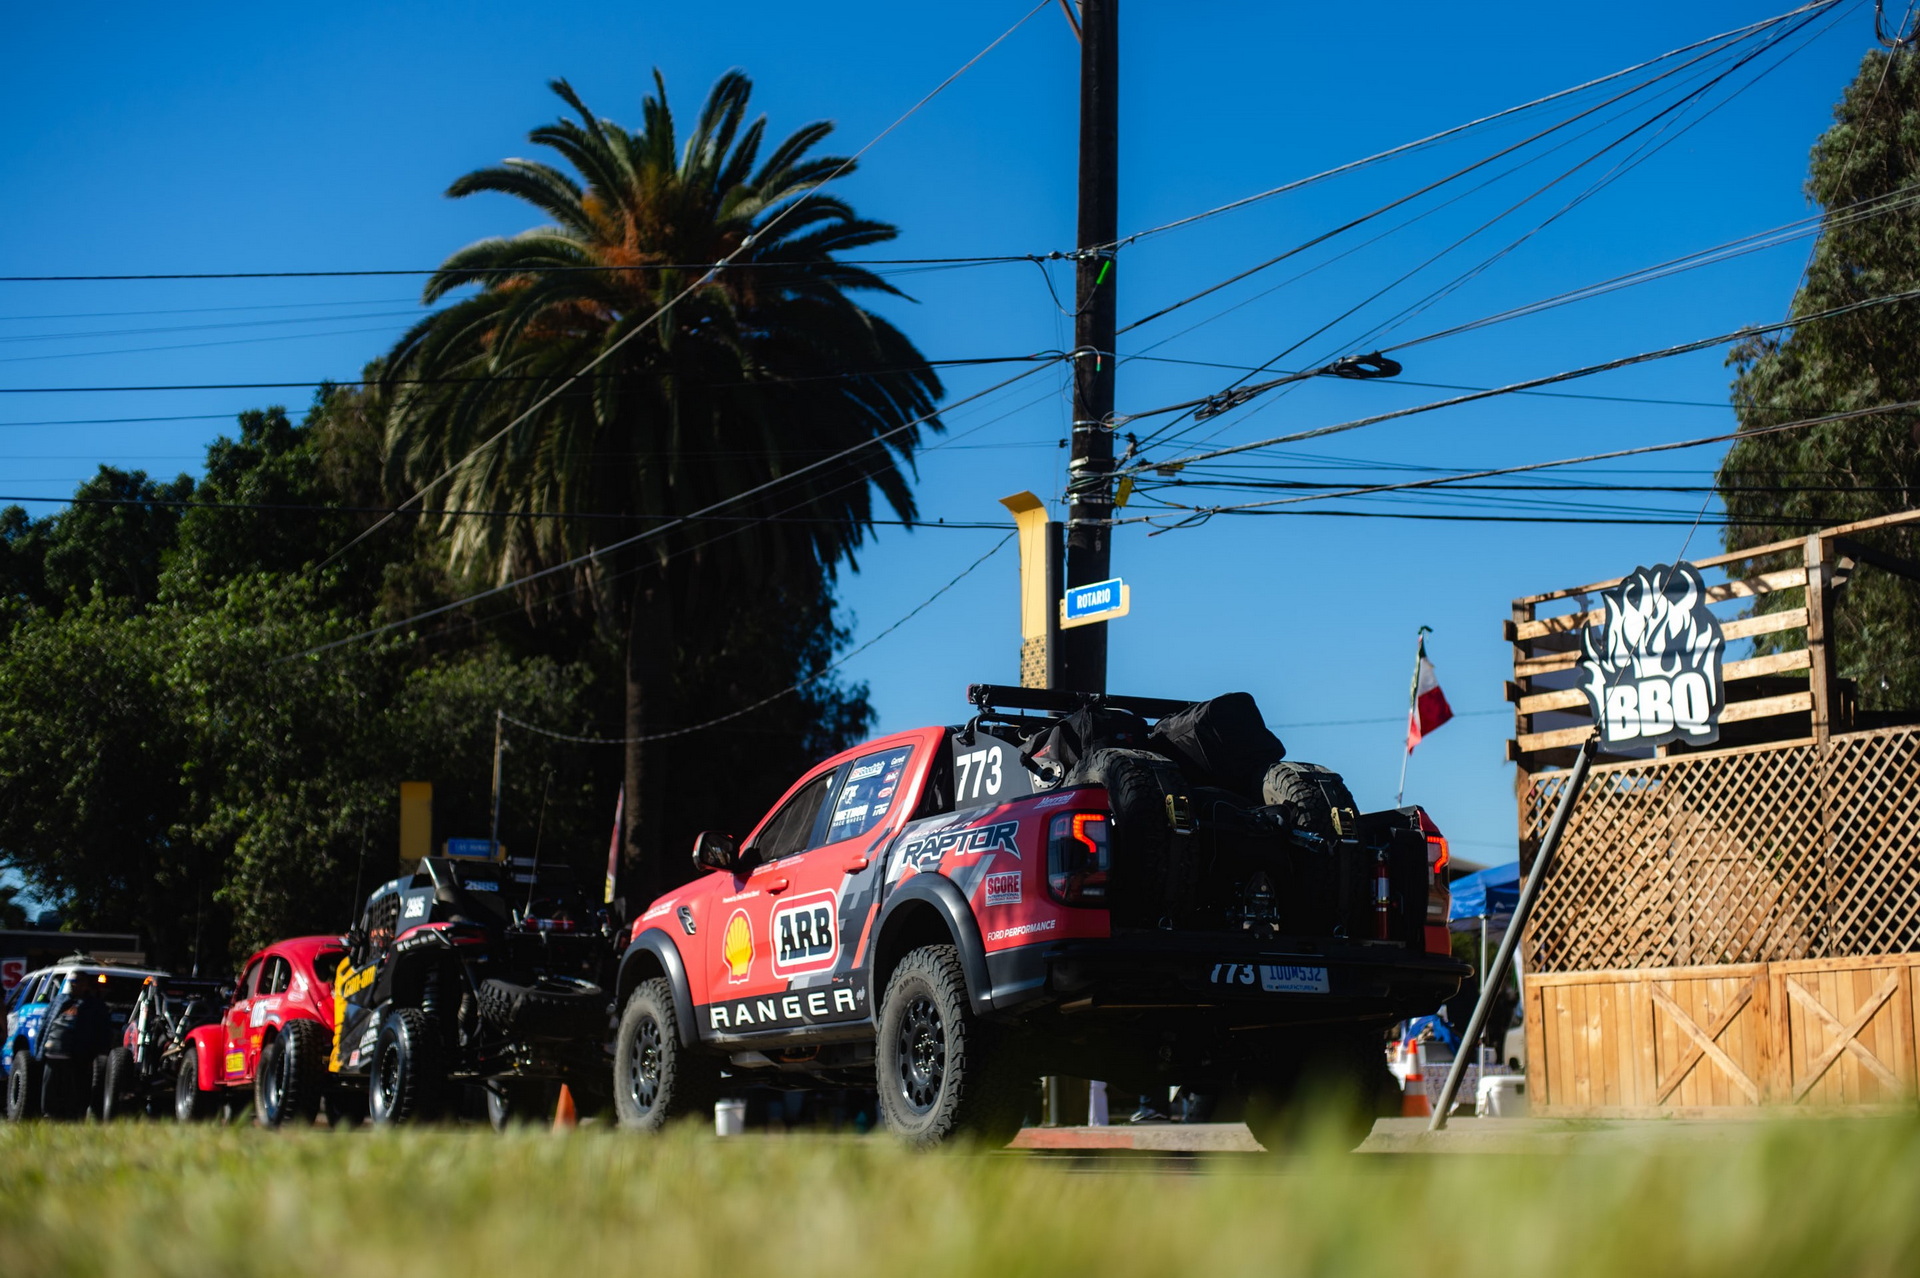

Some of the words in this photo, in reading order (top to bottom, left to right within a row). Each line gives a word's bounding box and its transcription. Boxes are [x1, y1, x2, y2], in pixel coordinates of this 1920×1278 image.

[1077, 588, 1111, 609] ROTARIO
[1605, 672, 1711, 741] BBQ
[956, 746, 1003, 802] 773
[901, 820, 1022, 872] RAPTOR
[988, 875, 1020, 895] SCORE
[780, 907, 834, 961] ARB
[986, 929, 1005, 942] FORD
[1004, 919, 1057, 938] PERFORMANCE
[711, 988, 856, 1030] RANGER
